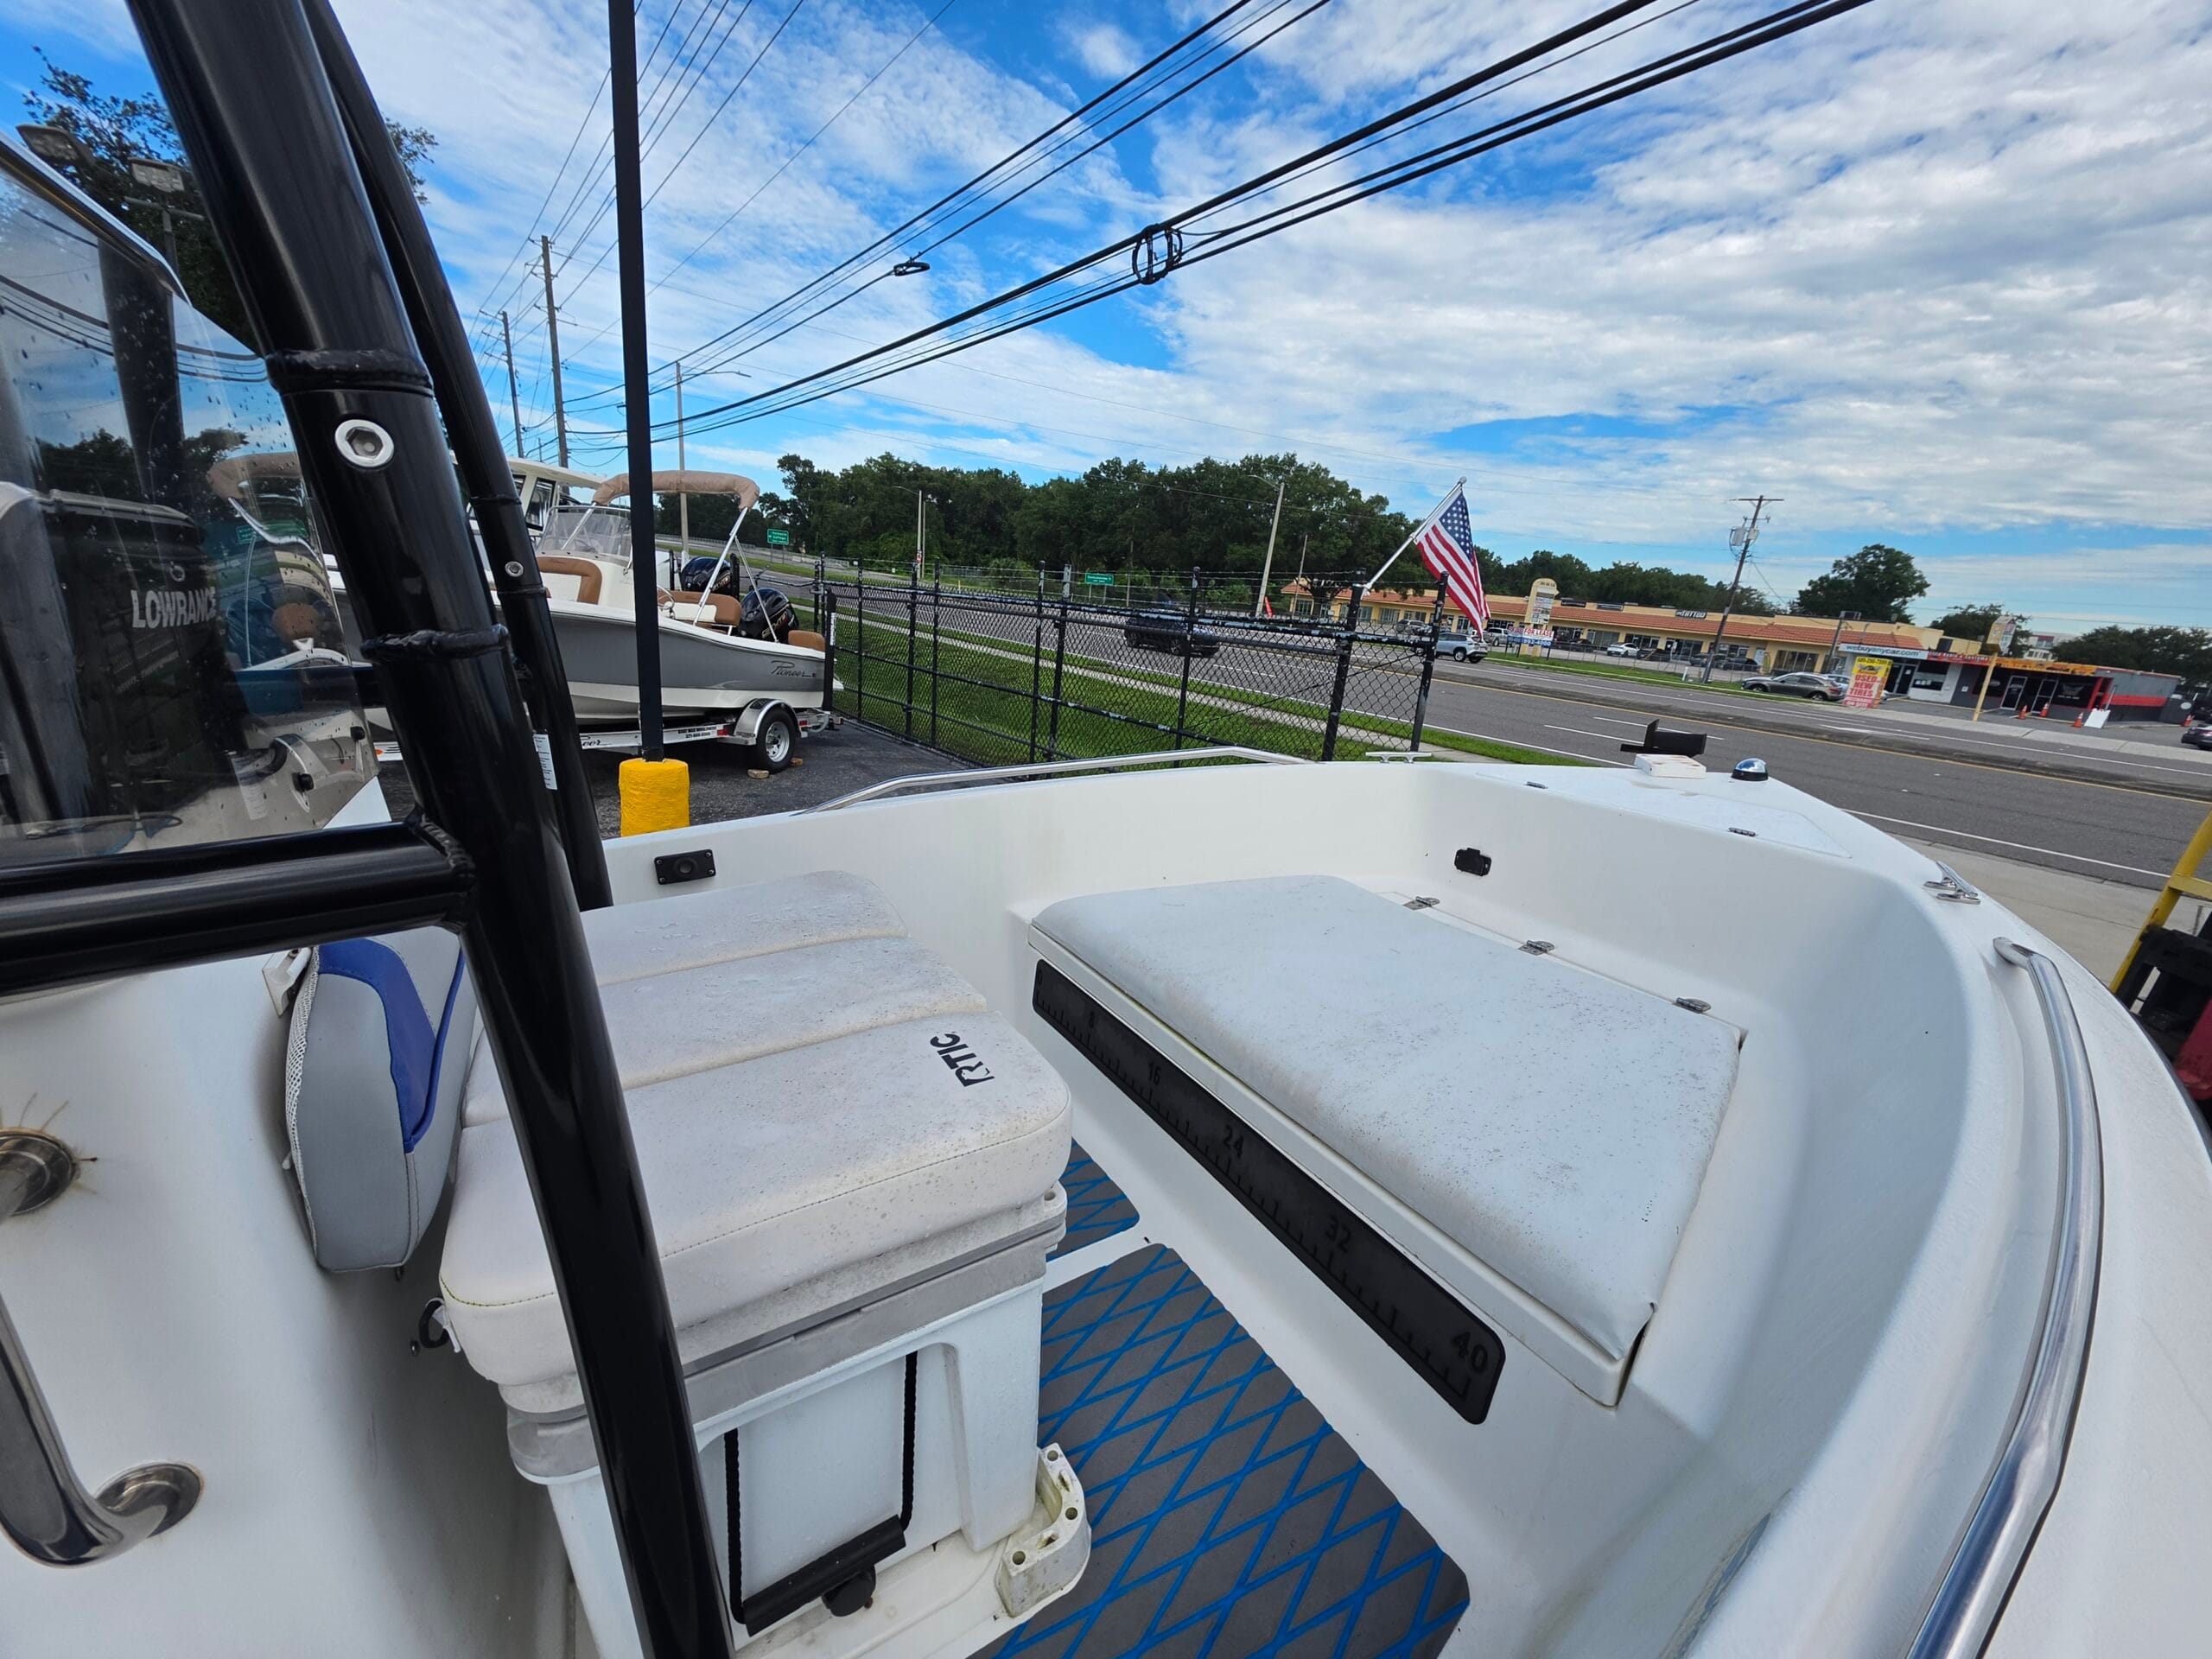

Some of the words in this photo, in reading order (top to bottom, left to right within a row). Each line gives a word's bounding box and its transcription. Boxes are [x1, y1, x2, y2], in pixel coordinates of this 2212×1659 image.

[1850, 688, 1873, 697] TIRES
[1088, 1010, 1096, 1029] 8
[930, 1033, 995, 1087] RTIC
[1148, 1061, 1161, 1085] 16
[1223, 1123, 1245, 1160] 24
[1325, 1213, 1352, 1255] 32
[1452, 1330, 1490, 1375] 40
